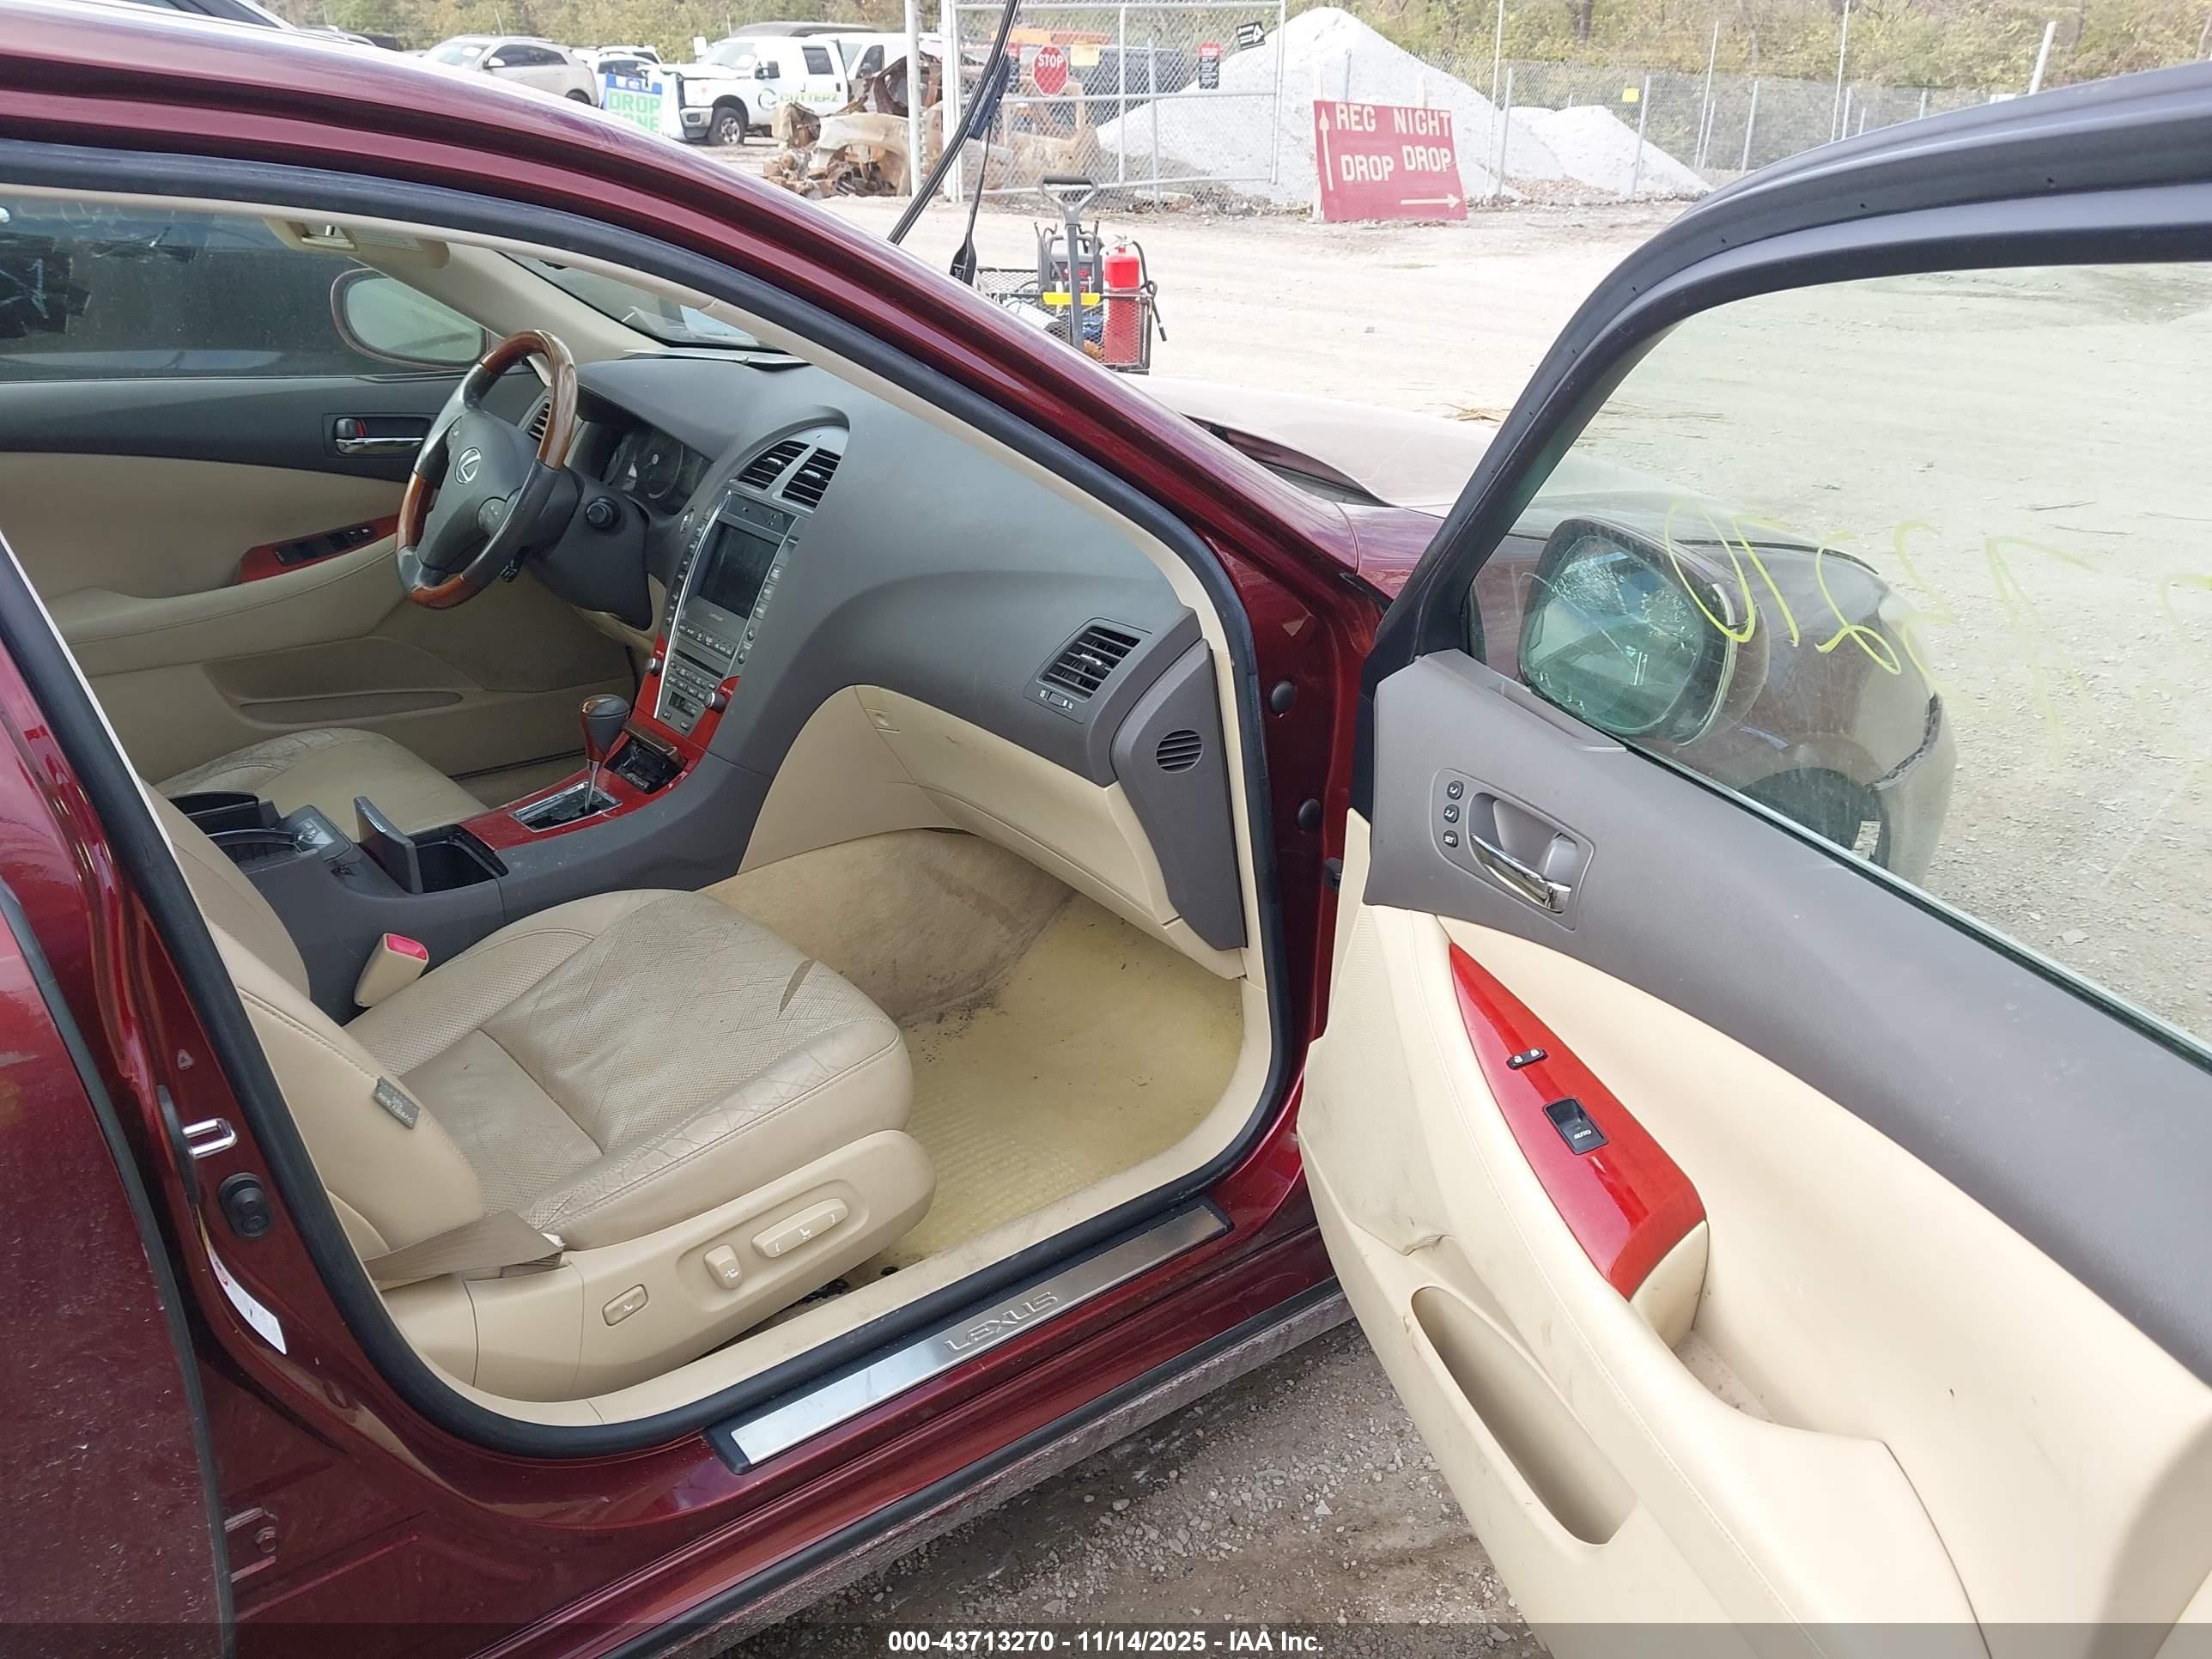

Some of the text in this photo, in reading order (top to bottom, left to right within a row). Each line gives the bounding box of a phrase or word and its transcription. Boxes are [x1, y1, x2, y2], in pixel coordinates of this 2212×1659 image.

[1037, 53, 1065, 69] STOP
[608, 91, 660, 114] DROP
[1334, 102, 1377, 132] REG
[1392, 106, 1452, 137] NIGHT
[1340, 153, 1395, 182] DROP
[1401, 144, 1453, 173] DROP
[1574, 1129, 1592, 1139] AUTO
[943, 1291, 1059, 1353] LEXUS
